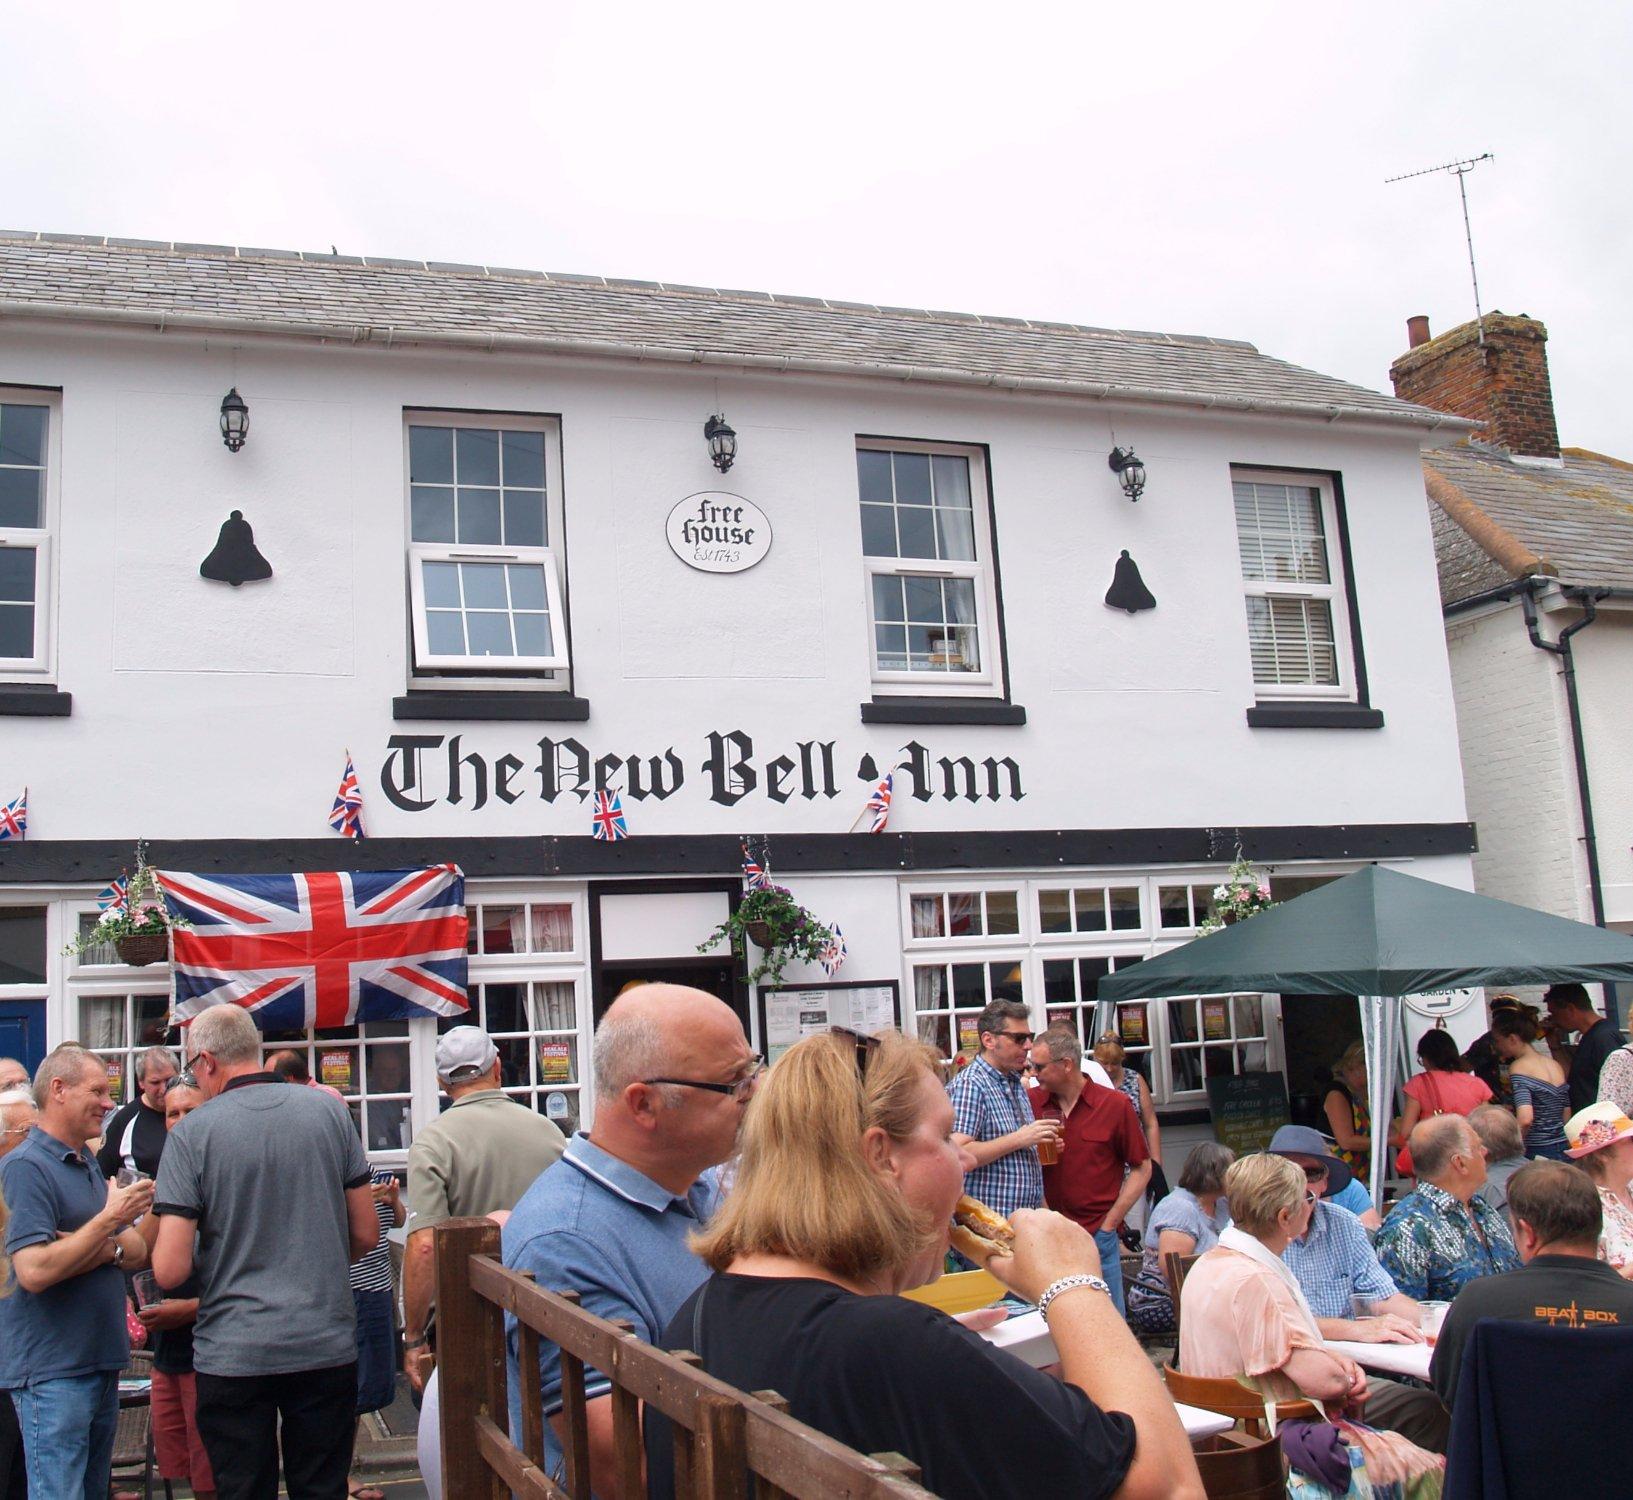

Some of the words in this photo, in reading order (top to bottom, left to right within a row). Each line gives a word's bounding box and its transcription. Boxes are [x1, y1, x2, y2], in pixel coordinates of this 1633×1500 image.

[697, 499, 744, 524] free
[681, 518, 755, 547] house
[714, 549, 741, 563] 1743
[380, 734, 489, 812] The
[534, 736, 685, 804] New
[701, 729, 842, 807] Bell
[895, 740, 1027, 804] Inn
[1535, 1301, 1578, 1322] BEAT
[1583, 1309, 1619, 1323] BOX
